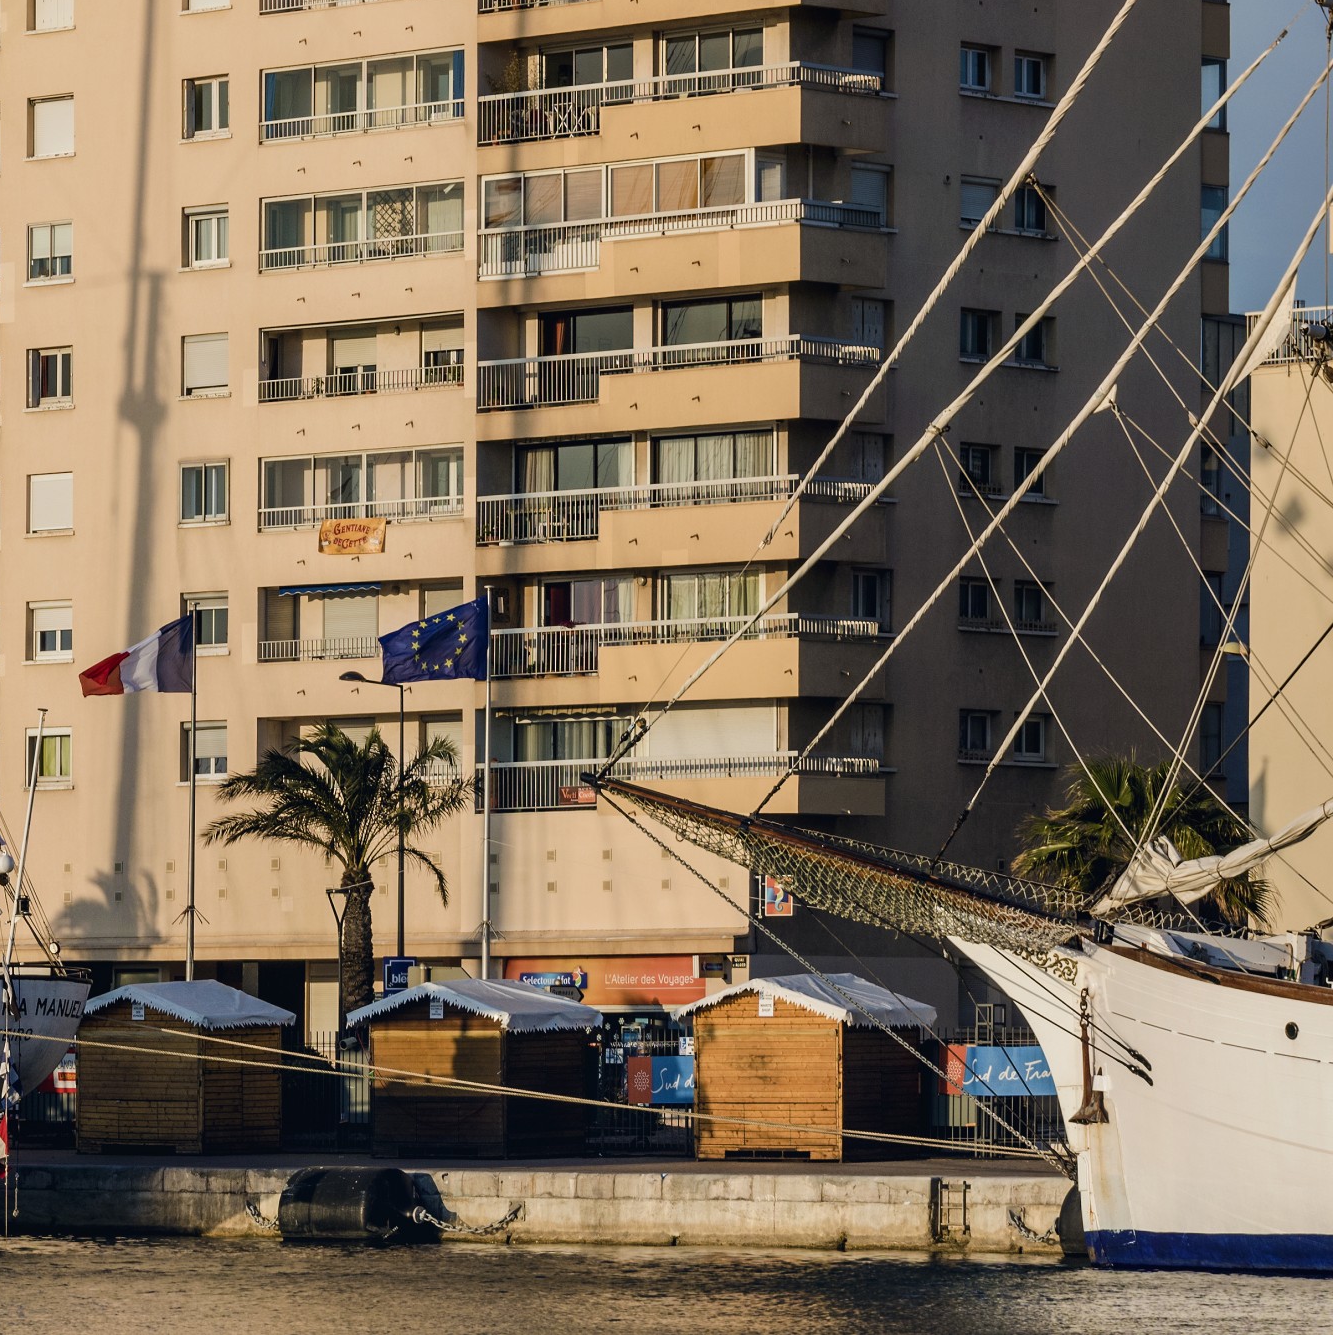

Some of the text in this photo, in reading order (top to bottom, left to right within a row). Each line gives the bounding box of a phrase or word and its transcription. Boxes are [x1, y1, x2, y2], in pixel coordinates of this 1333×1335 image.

[392, 974, 408, 983] ble
[605, 973, 694, 986] L'Atelier des Voyages
[35, 998, 84, 1019] MANUEL
[651, 1067, 681, 1094] Sud
[962, 1058, 993, 1085] Sud
[998, 1065, 1019, 1081] de
